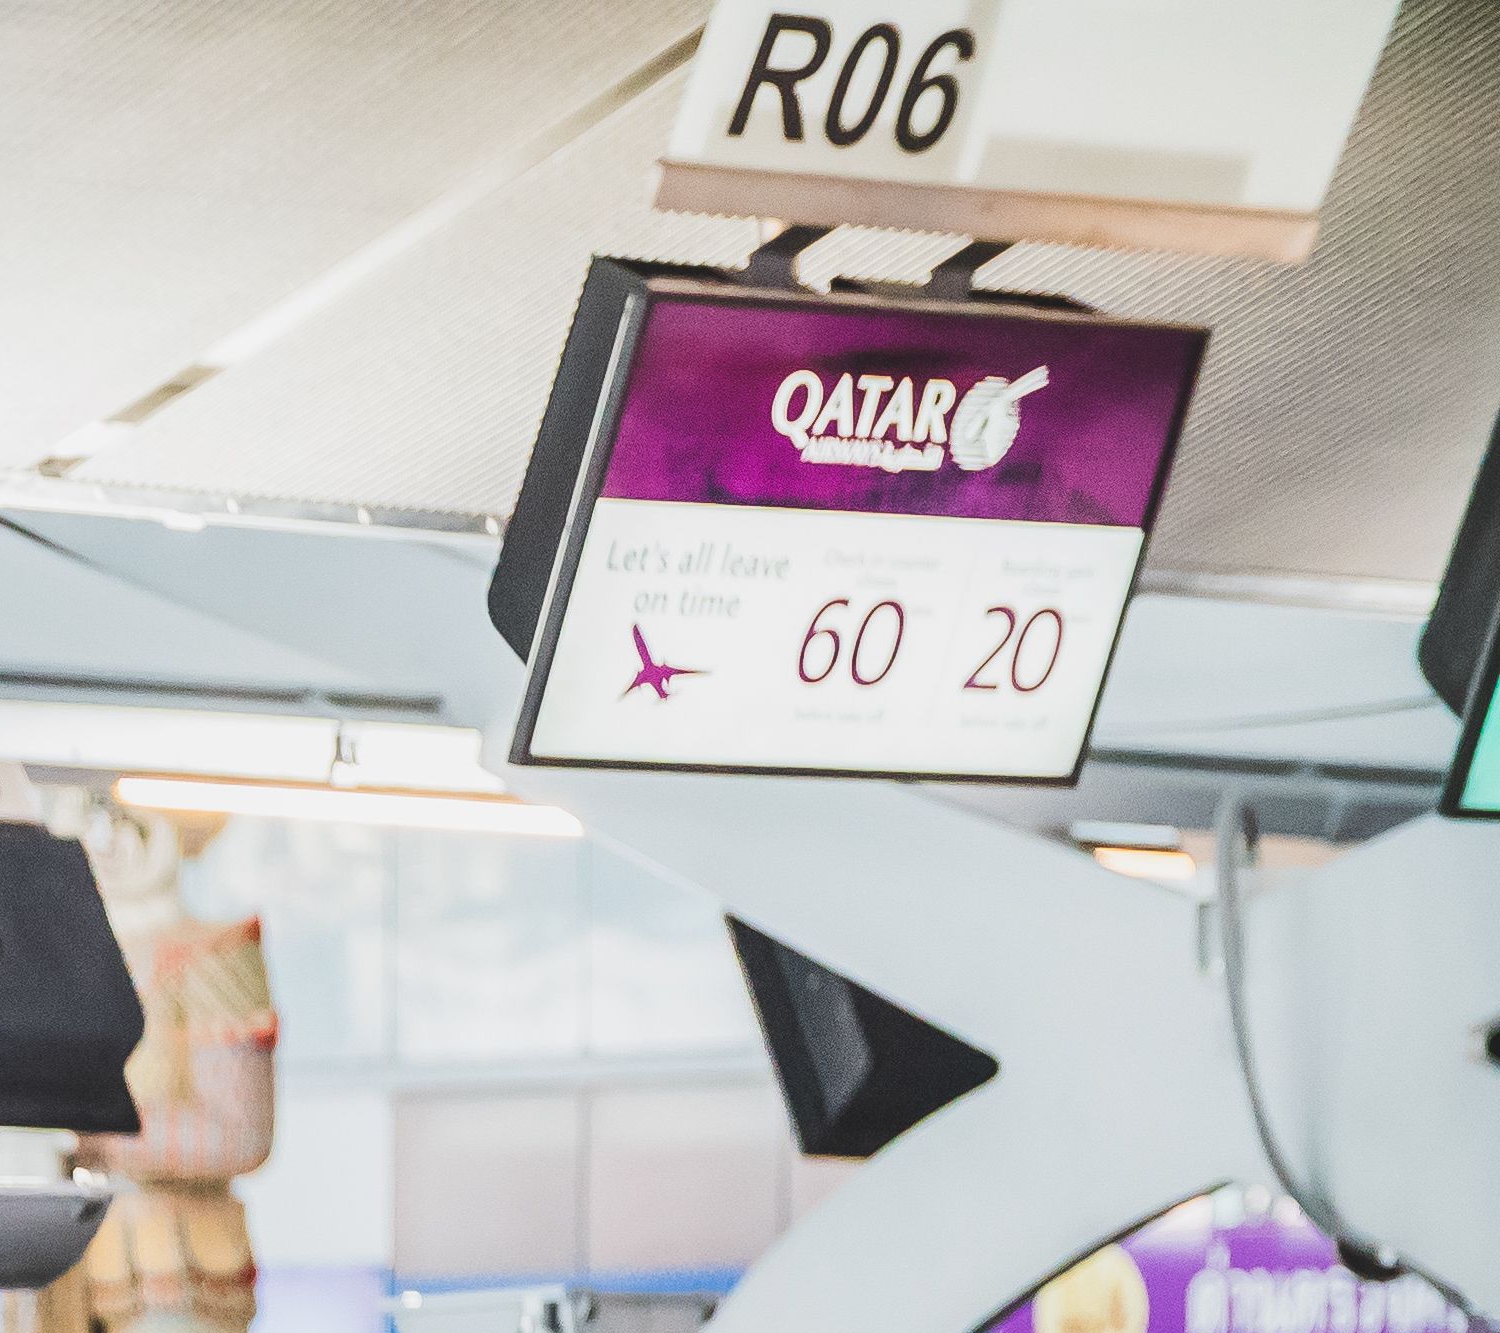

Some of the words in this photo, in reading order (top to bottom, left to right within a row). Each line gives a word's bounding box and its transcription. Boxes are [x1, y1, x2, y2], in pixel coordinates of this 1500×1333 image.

[728, 14, 976, 154] R06
[771, 369, 957, 450] QATAR
[606, 541, 669, 574] Let's
[676, 541, 714, 576] all
[722, 544, 791, 580] leave
[633, 590, 670, 615] on
[677, 585, 741, 618] time
[798, 598, 905, 686] 60
[963, 605, 1065, 693] 20
